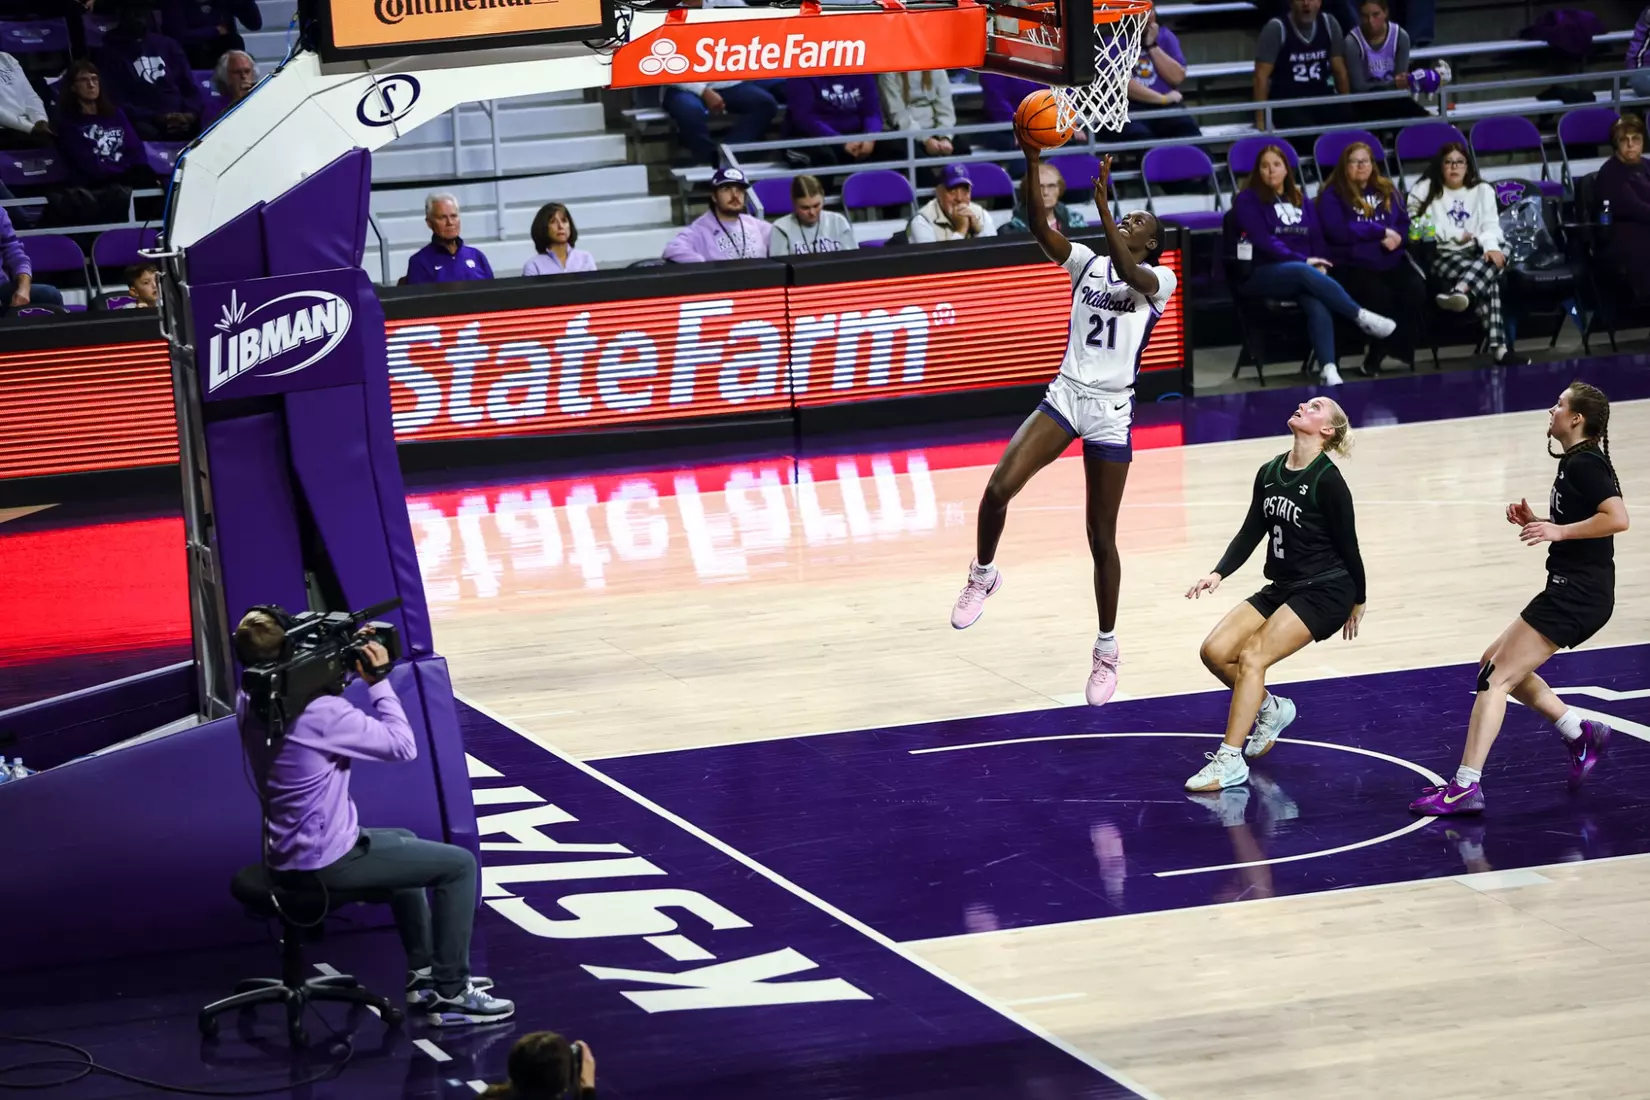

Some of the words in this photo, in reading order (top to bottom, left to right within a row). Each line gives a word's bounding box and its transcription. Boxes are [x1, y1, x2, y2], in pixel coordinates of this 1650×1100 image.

[1081, 285, 1137, 313] Wildcats
[208, 298, 339, 393] LIBMAN
[1085, 313, 1118, 350] 21
[1273, 524, 1285, 559] 2
